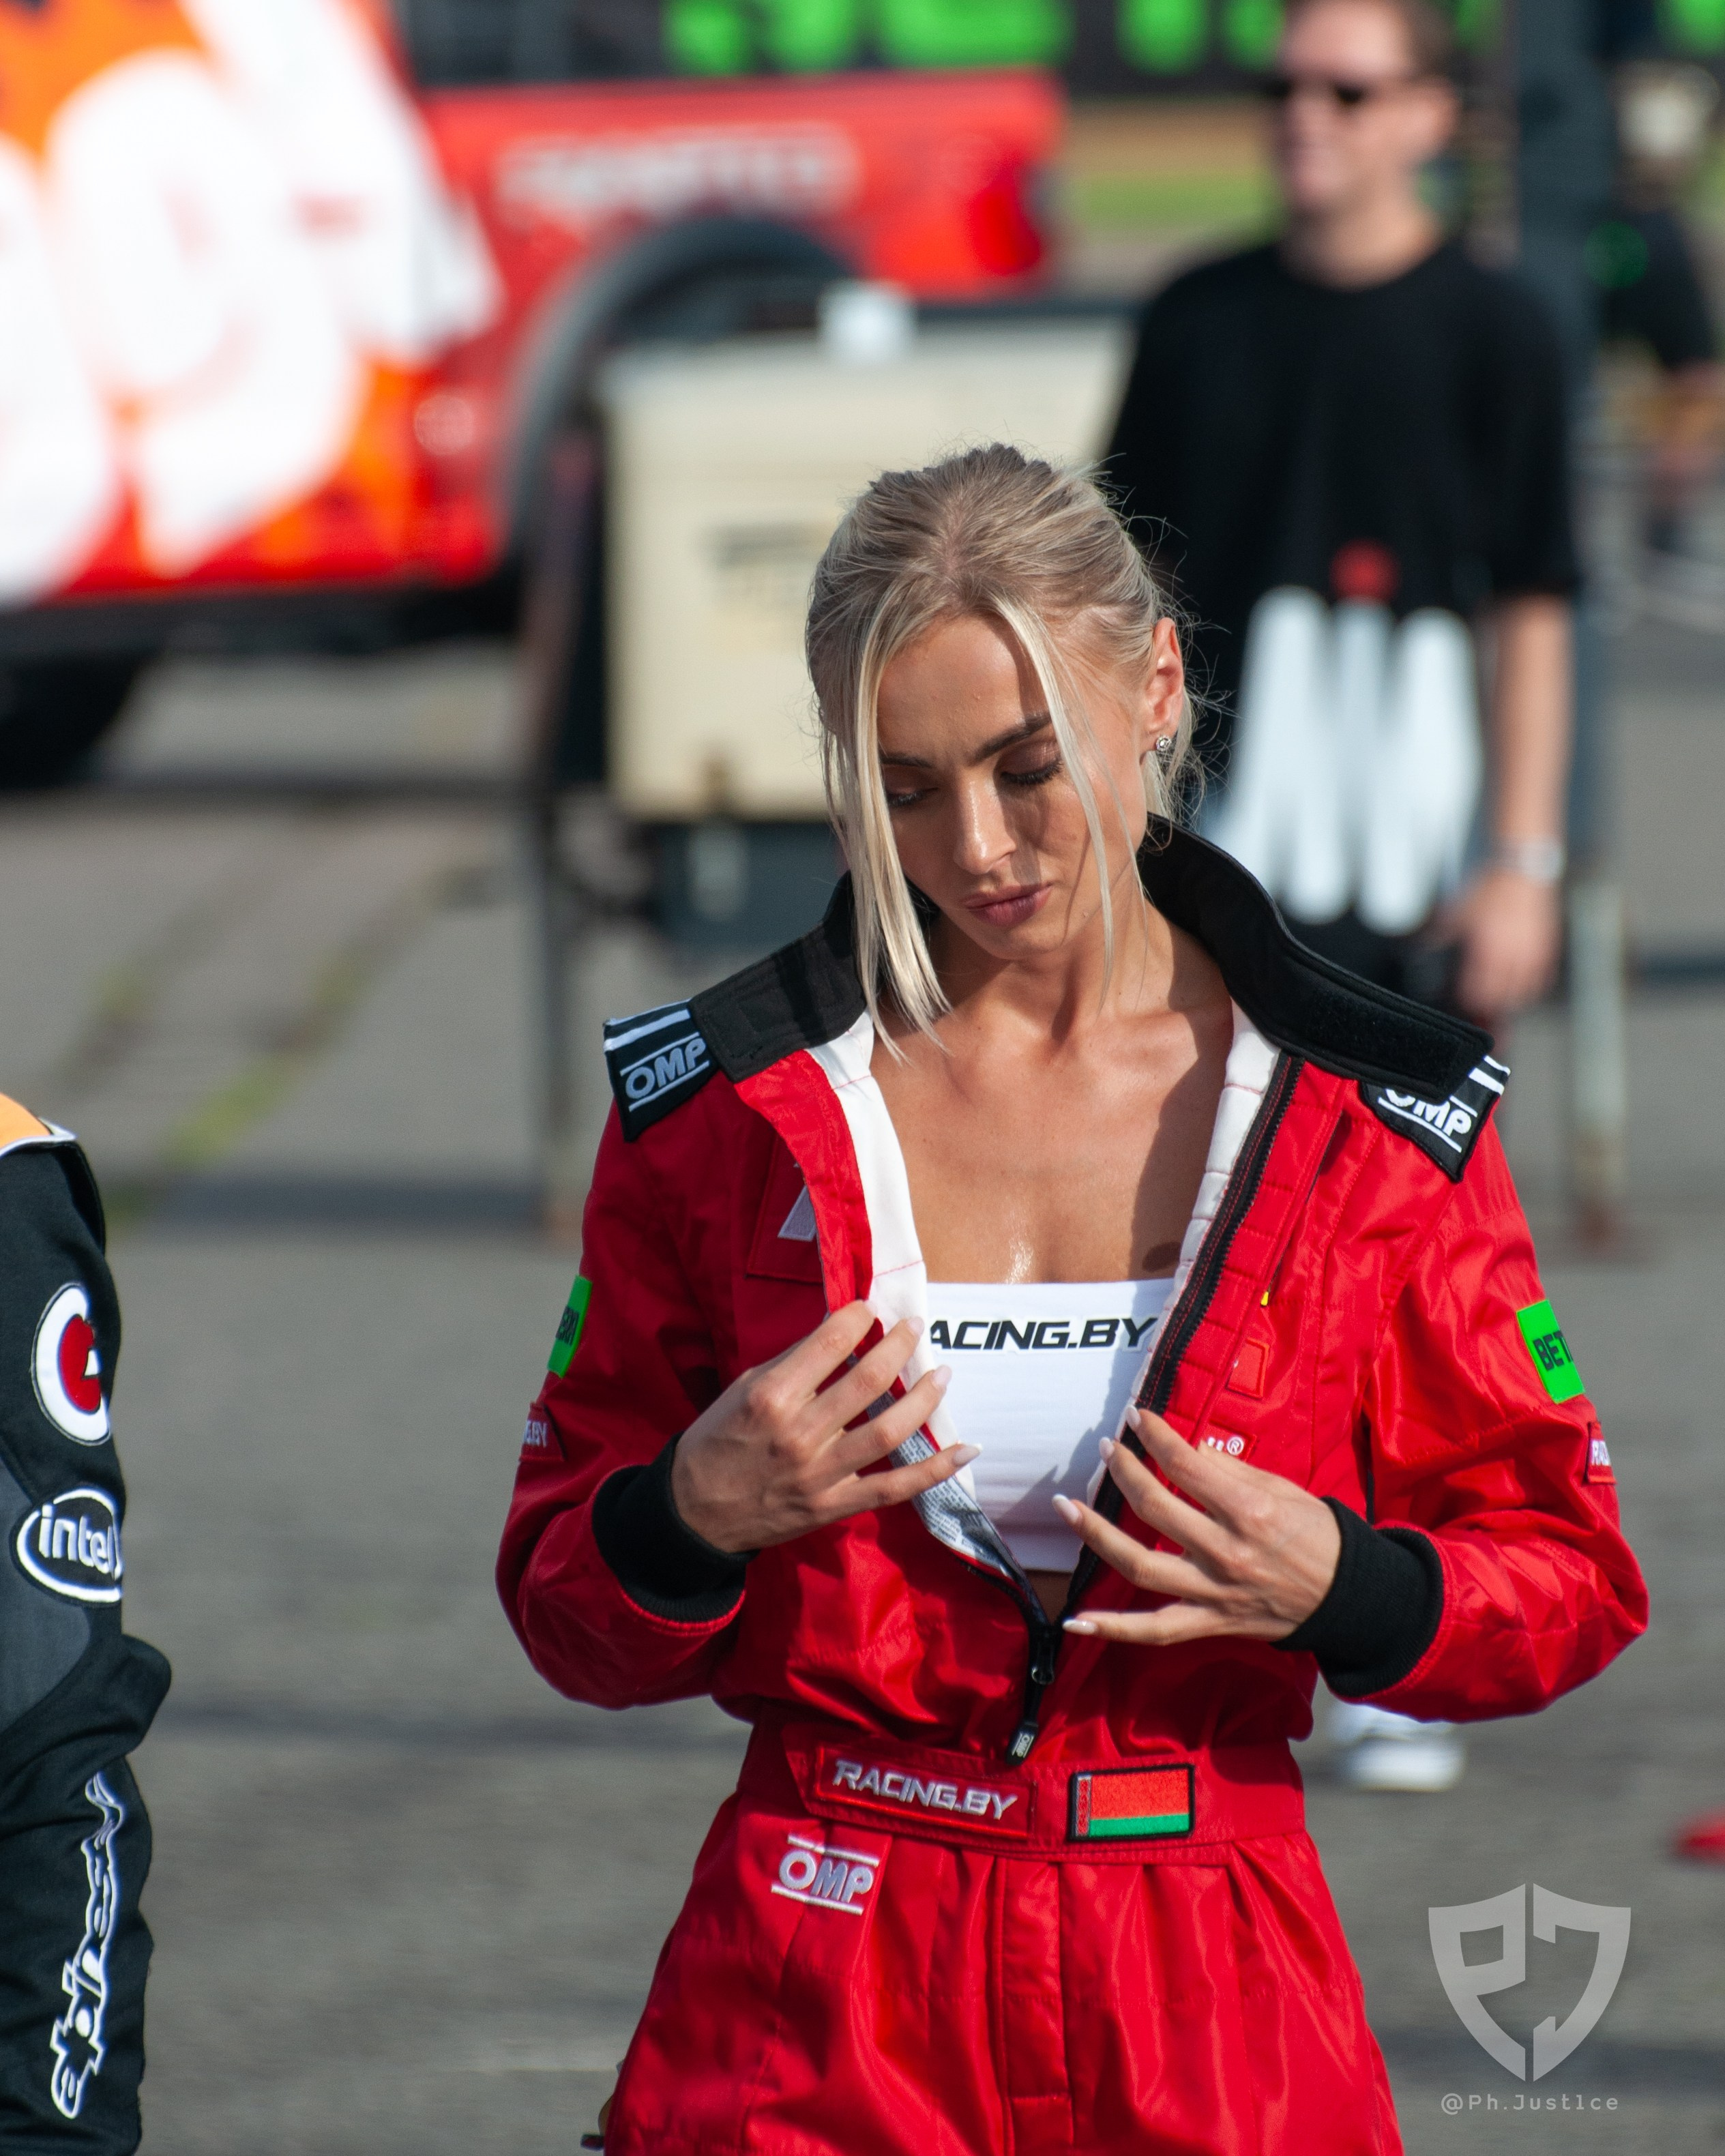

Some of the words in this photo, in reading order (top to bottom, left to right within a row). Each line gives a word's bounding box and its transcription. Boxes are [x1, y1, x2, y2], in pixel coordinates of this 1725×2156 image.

[625, 1037, 707, 1099] OMP
[1533, 1330, 1574, 1372] BET
[39, 1504, 115, 1579] intel
[833, 1759, 1018, 1820] RACING.BY
[779, 1849, 874, 1904] OMP
